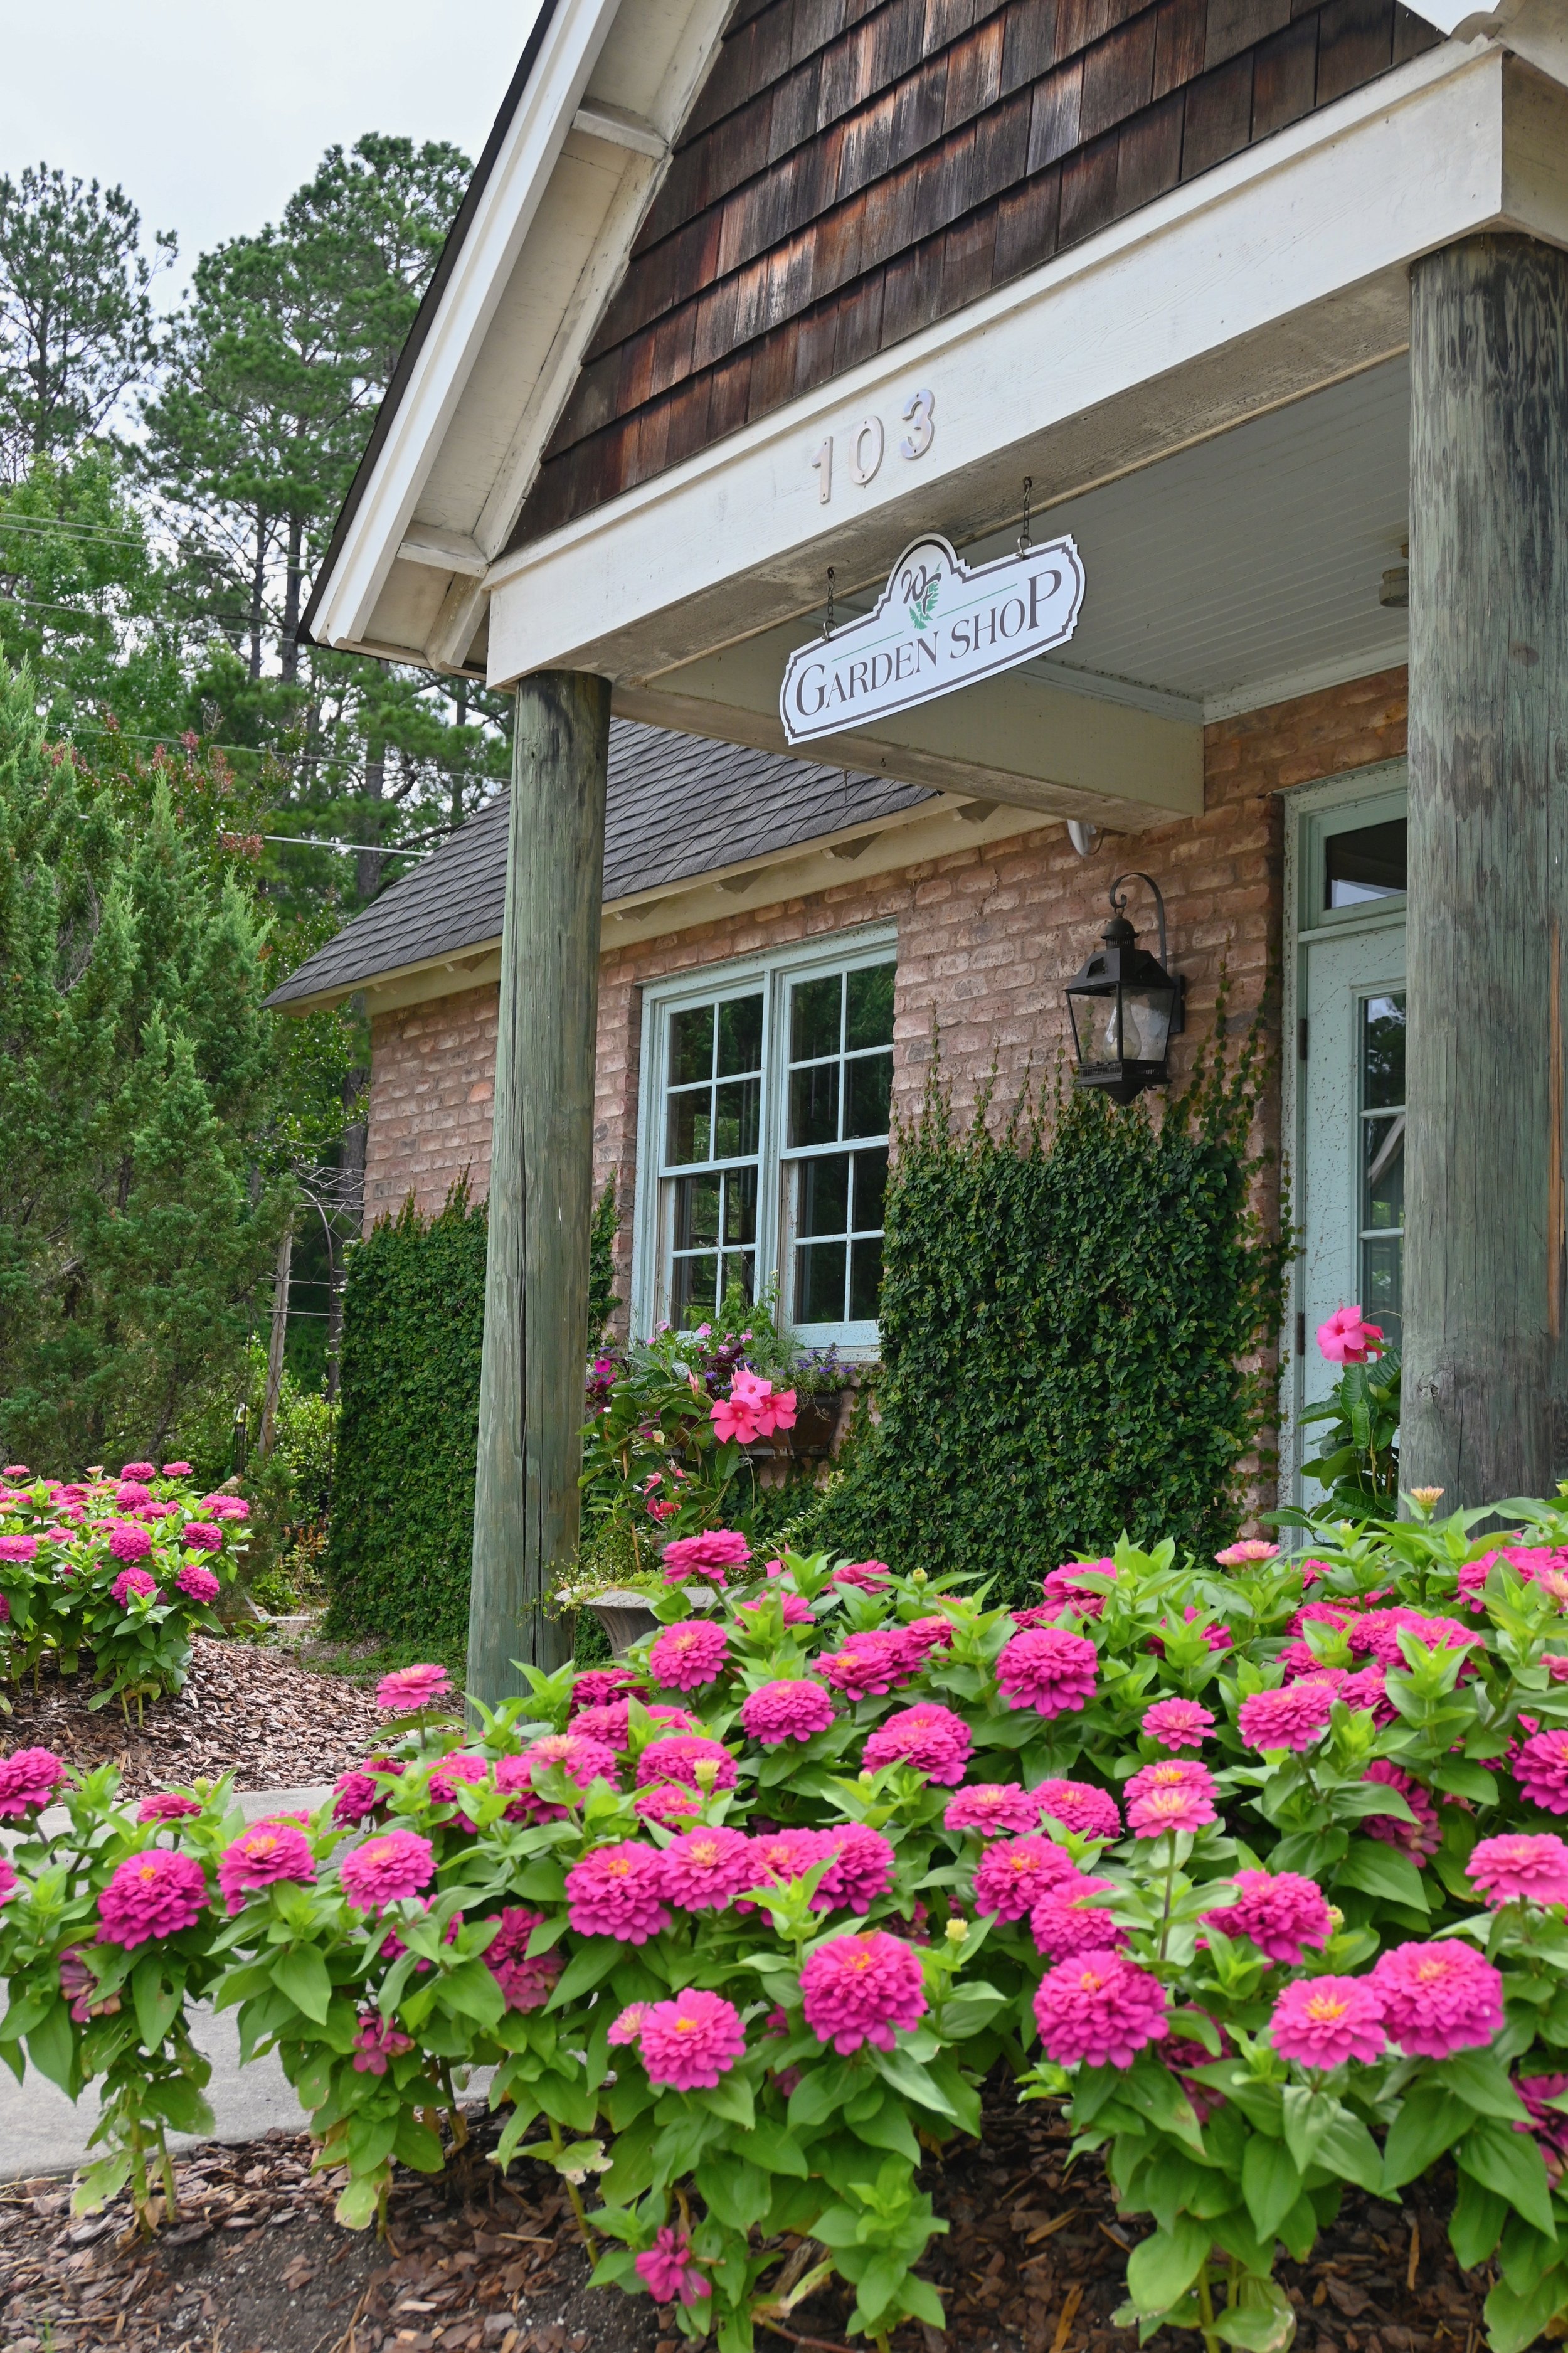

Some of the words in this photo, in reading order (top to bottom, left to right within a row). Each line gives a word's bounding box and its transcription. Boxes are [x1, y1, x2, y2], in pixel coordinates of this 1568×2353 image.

[811, 388, 935, 505] 103
[795, 630, 940, 716] GARDEN
[950, 569, 1062, 659] SHOP
